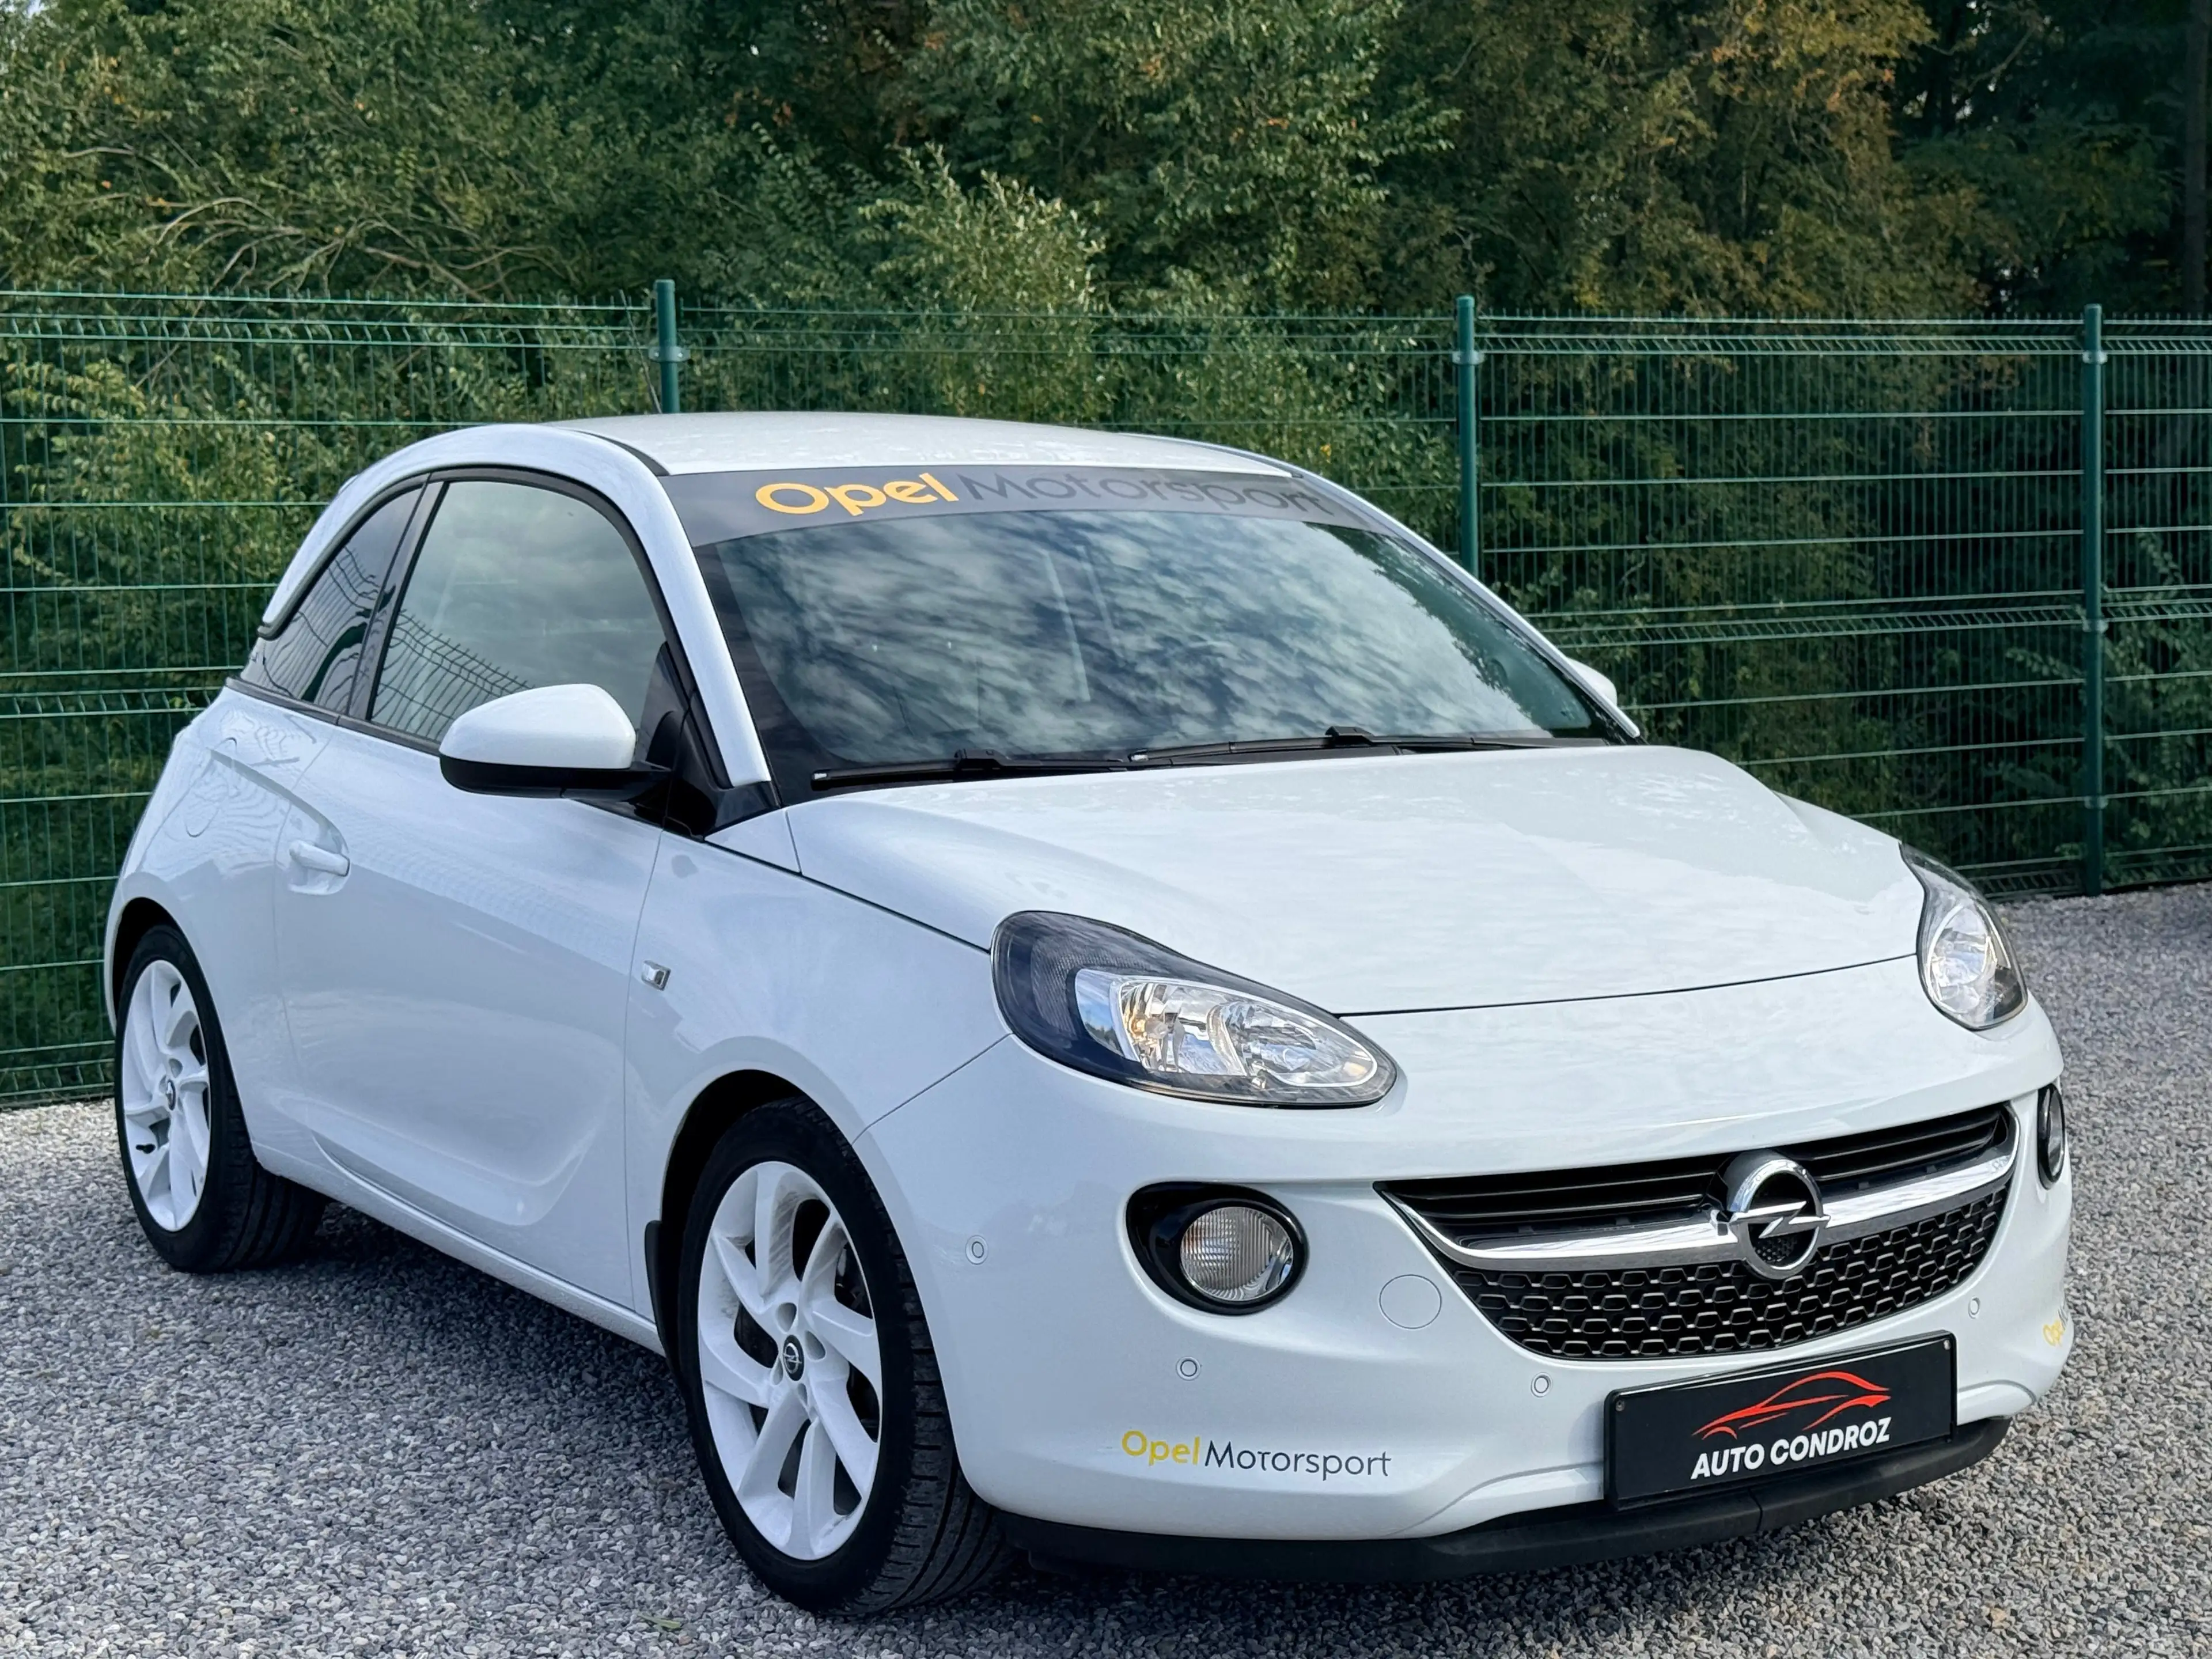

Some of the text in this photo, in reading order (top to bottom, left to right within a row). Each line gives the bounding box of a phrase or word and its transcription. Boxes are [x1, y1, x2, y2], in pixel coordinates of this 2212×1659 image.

[755, 473, 1334, 516] Opel Motorsport
[1122, 1430, 1391, 1481] Opel Motorsport
[1690, 1416, 1892, 1480] AUTO CONDROZ
